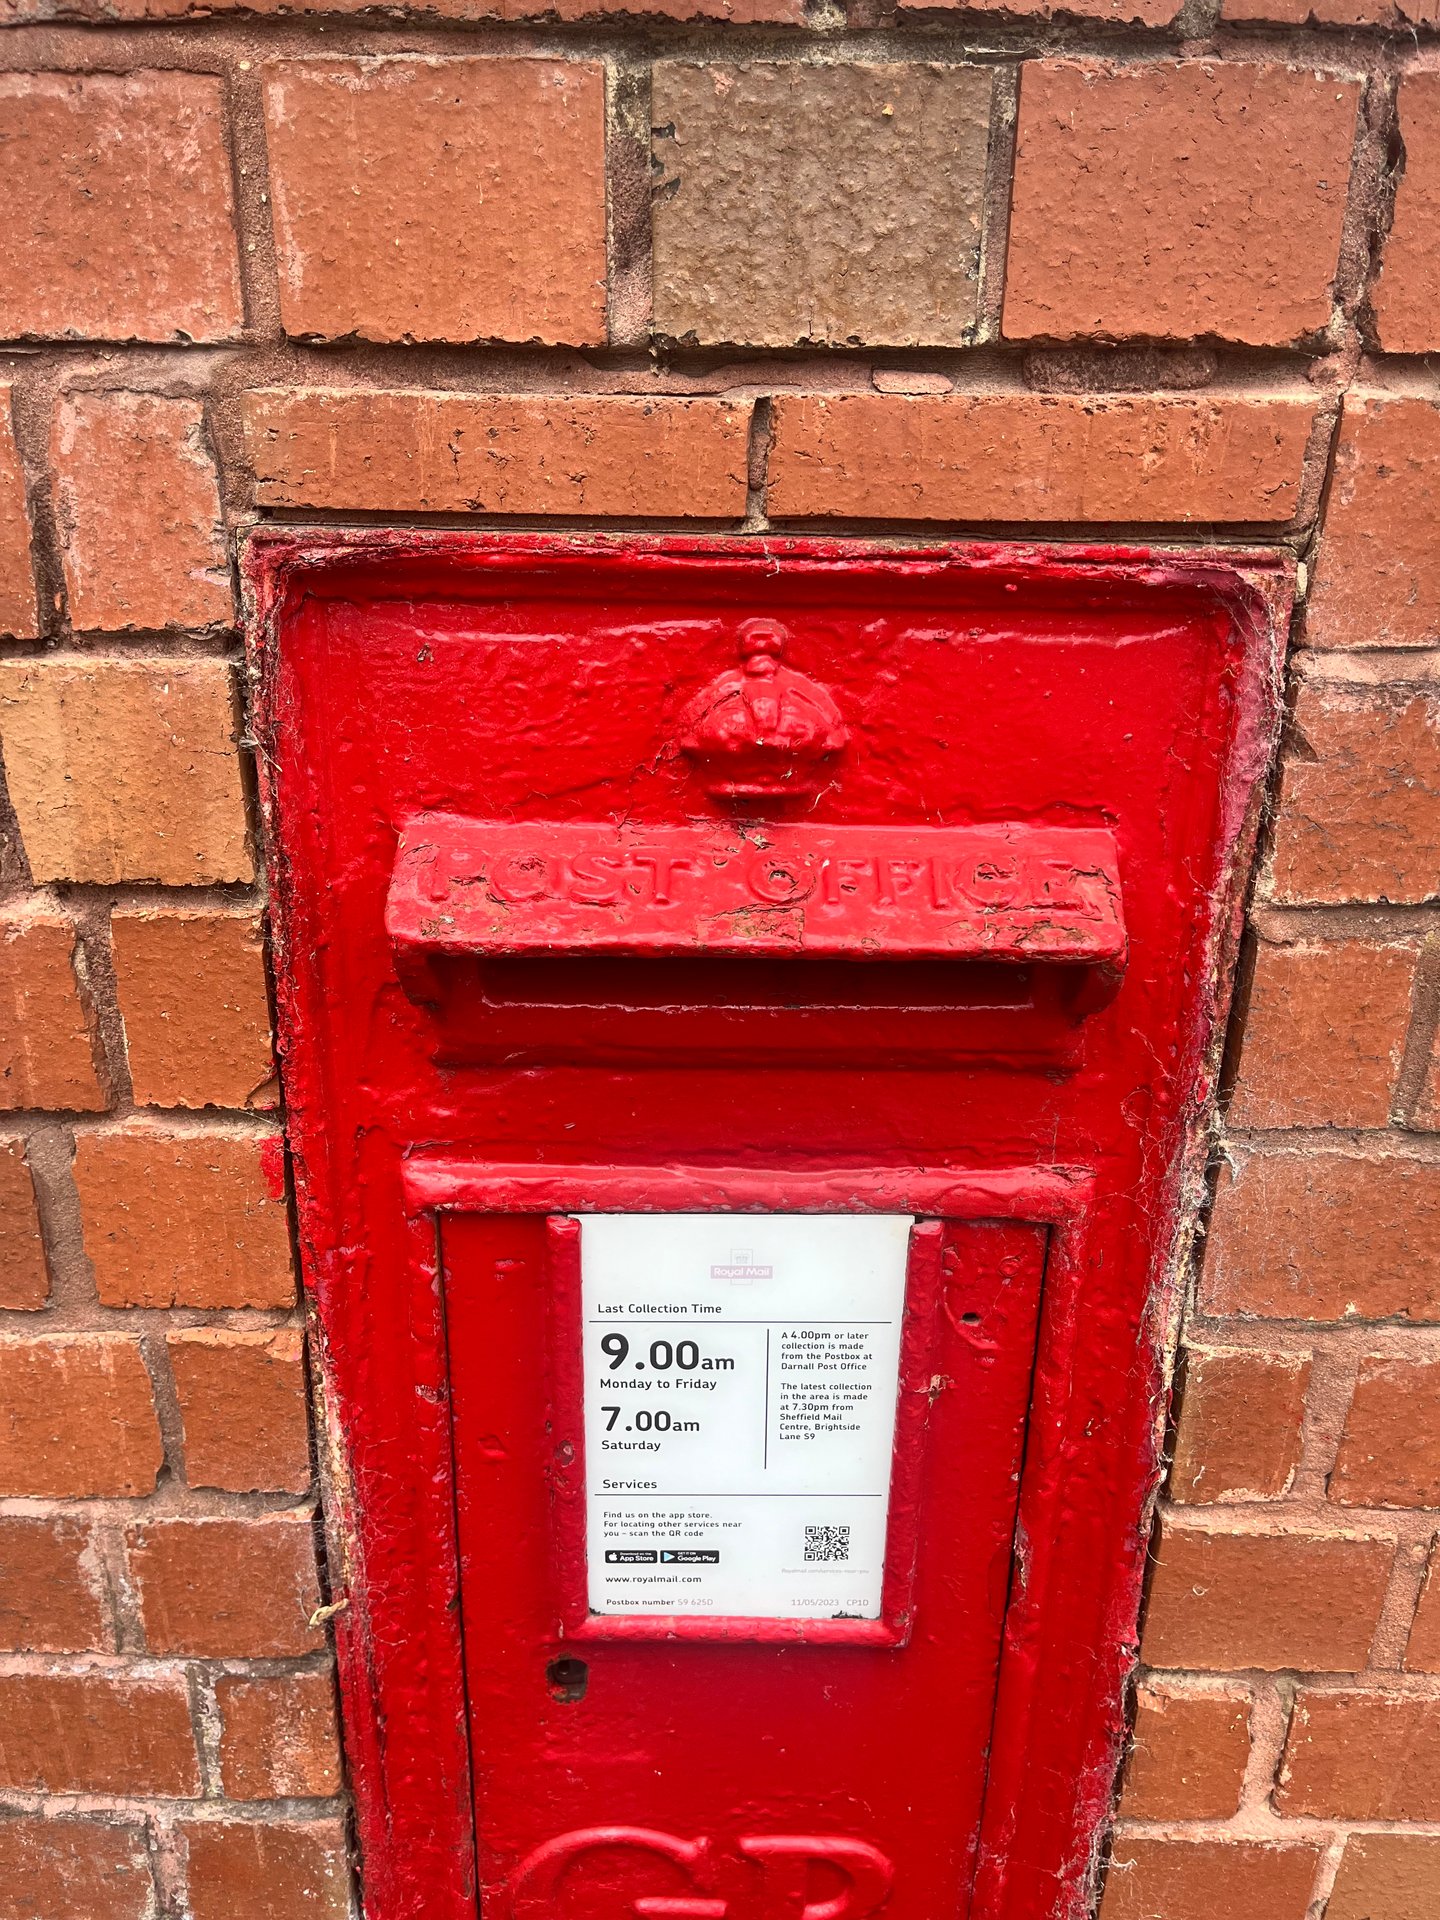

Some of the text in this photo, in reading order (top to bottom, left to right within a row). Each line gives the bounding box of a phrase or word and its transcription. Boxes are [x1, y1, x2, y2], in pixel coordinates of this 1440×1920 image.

[428, 848, 1080, 909] POST OFFICE
[713, 1267, 770, 1278] Royal Mail
[597, 1303, 722, 1314] Last Collection Time
[781, 1331, 789, 1339] A
[790, 1330, 831, 1341] 4.00pm
[847, 1332, 869, 1340] later
[781, 1342, 864, 1350] collection is made
[600, 1332, 735, 1371] 9.00am
[781, 1352, 804, 1360] from
[806, 1352, 822, 1360] the
[824, 1352, 861, 1360] Postbox
[781, 1362, 867, 1371] Darnall Post Office
[599, 1378, 718, 1391] Monday to Friday
[780, 1382, 872, 1391] The latest collection
[780, 1392, 789, 1400] in
[832, 1392, 840, 1401] is
[843, 1392, 869, 1401] made
[792, 1402, 829, 1412] 7.30pm
[831, 1403, 854, 1411] from
[600, 1405, 700, 1432] 7.00am
[779, 1413, 843, 1421] Sheffield Mail
[779, 1422, 861, 1432] Centre, Brightside
[779, 1432, 816, 1440] Lane S9
[601, 1439, 661, 1453] Saturday
[602, 1478, 658, 1489] Services
[603, 1511, 622, 1519] Find
[651, 1511, 666, 1519] the
[603, 1520, 618, 1528] For
[620, 1520, 655, 1529] locating
[668, 1529, 681, 1537] QR
[677, 1555, 716, 1563] Google Play
[605, 1575, 702, 1585] www.royalmail.com
[606, 1598, 639, 1606] Postbox
[677, 1598, 688, 1606] S9
[690, 1598, 714, 1606] 625D
[791, 1598, 840, 1606] 11/05/2023
